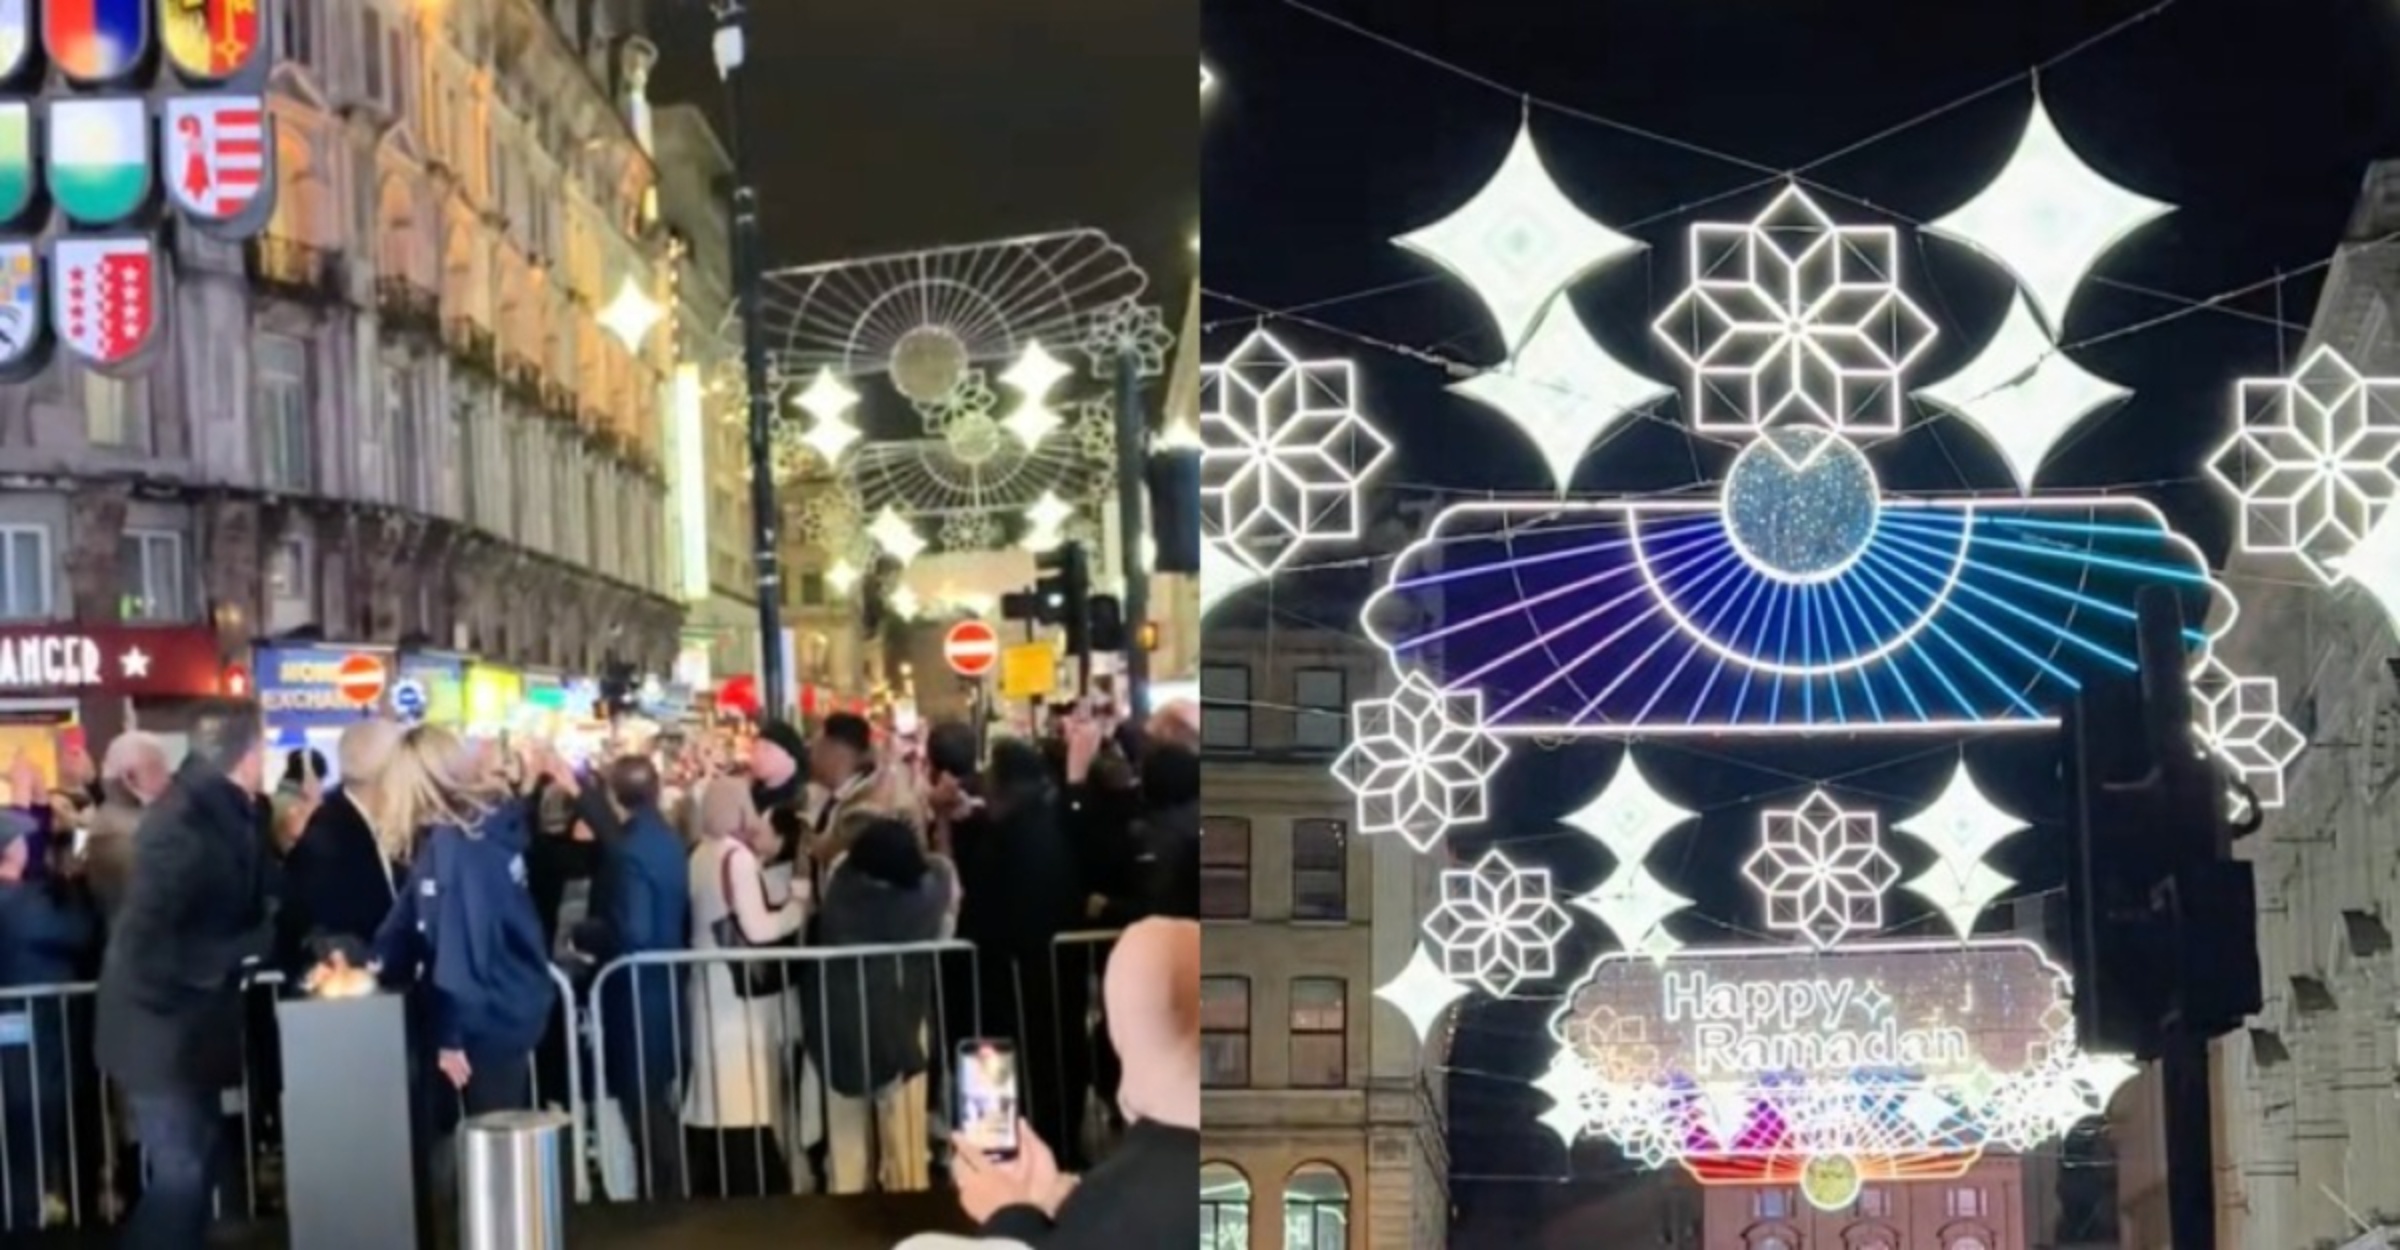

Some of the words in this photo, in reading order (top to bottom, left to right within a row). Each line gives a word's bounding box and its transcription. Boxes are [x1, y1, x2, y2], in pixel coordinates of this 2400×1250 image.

[280, 661, 343, 684] MONE
[1664, 970, 1853, 1030] Happy
[1695, 1016, 1969, 1074] Ramadan
